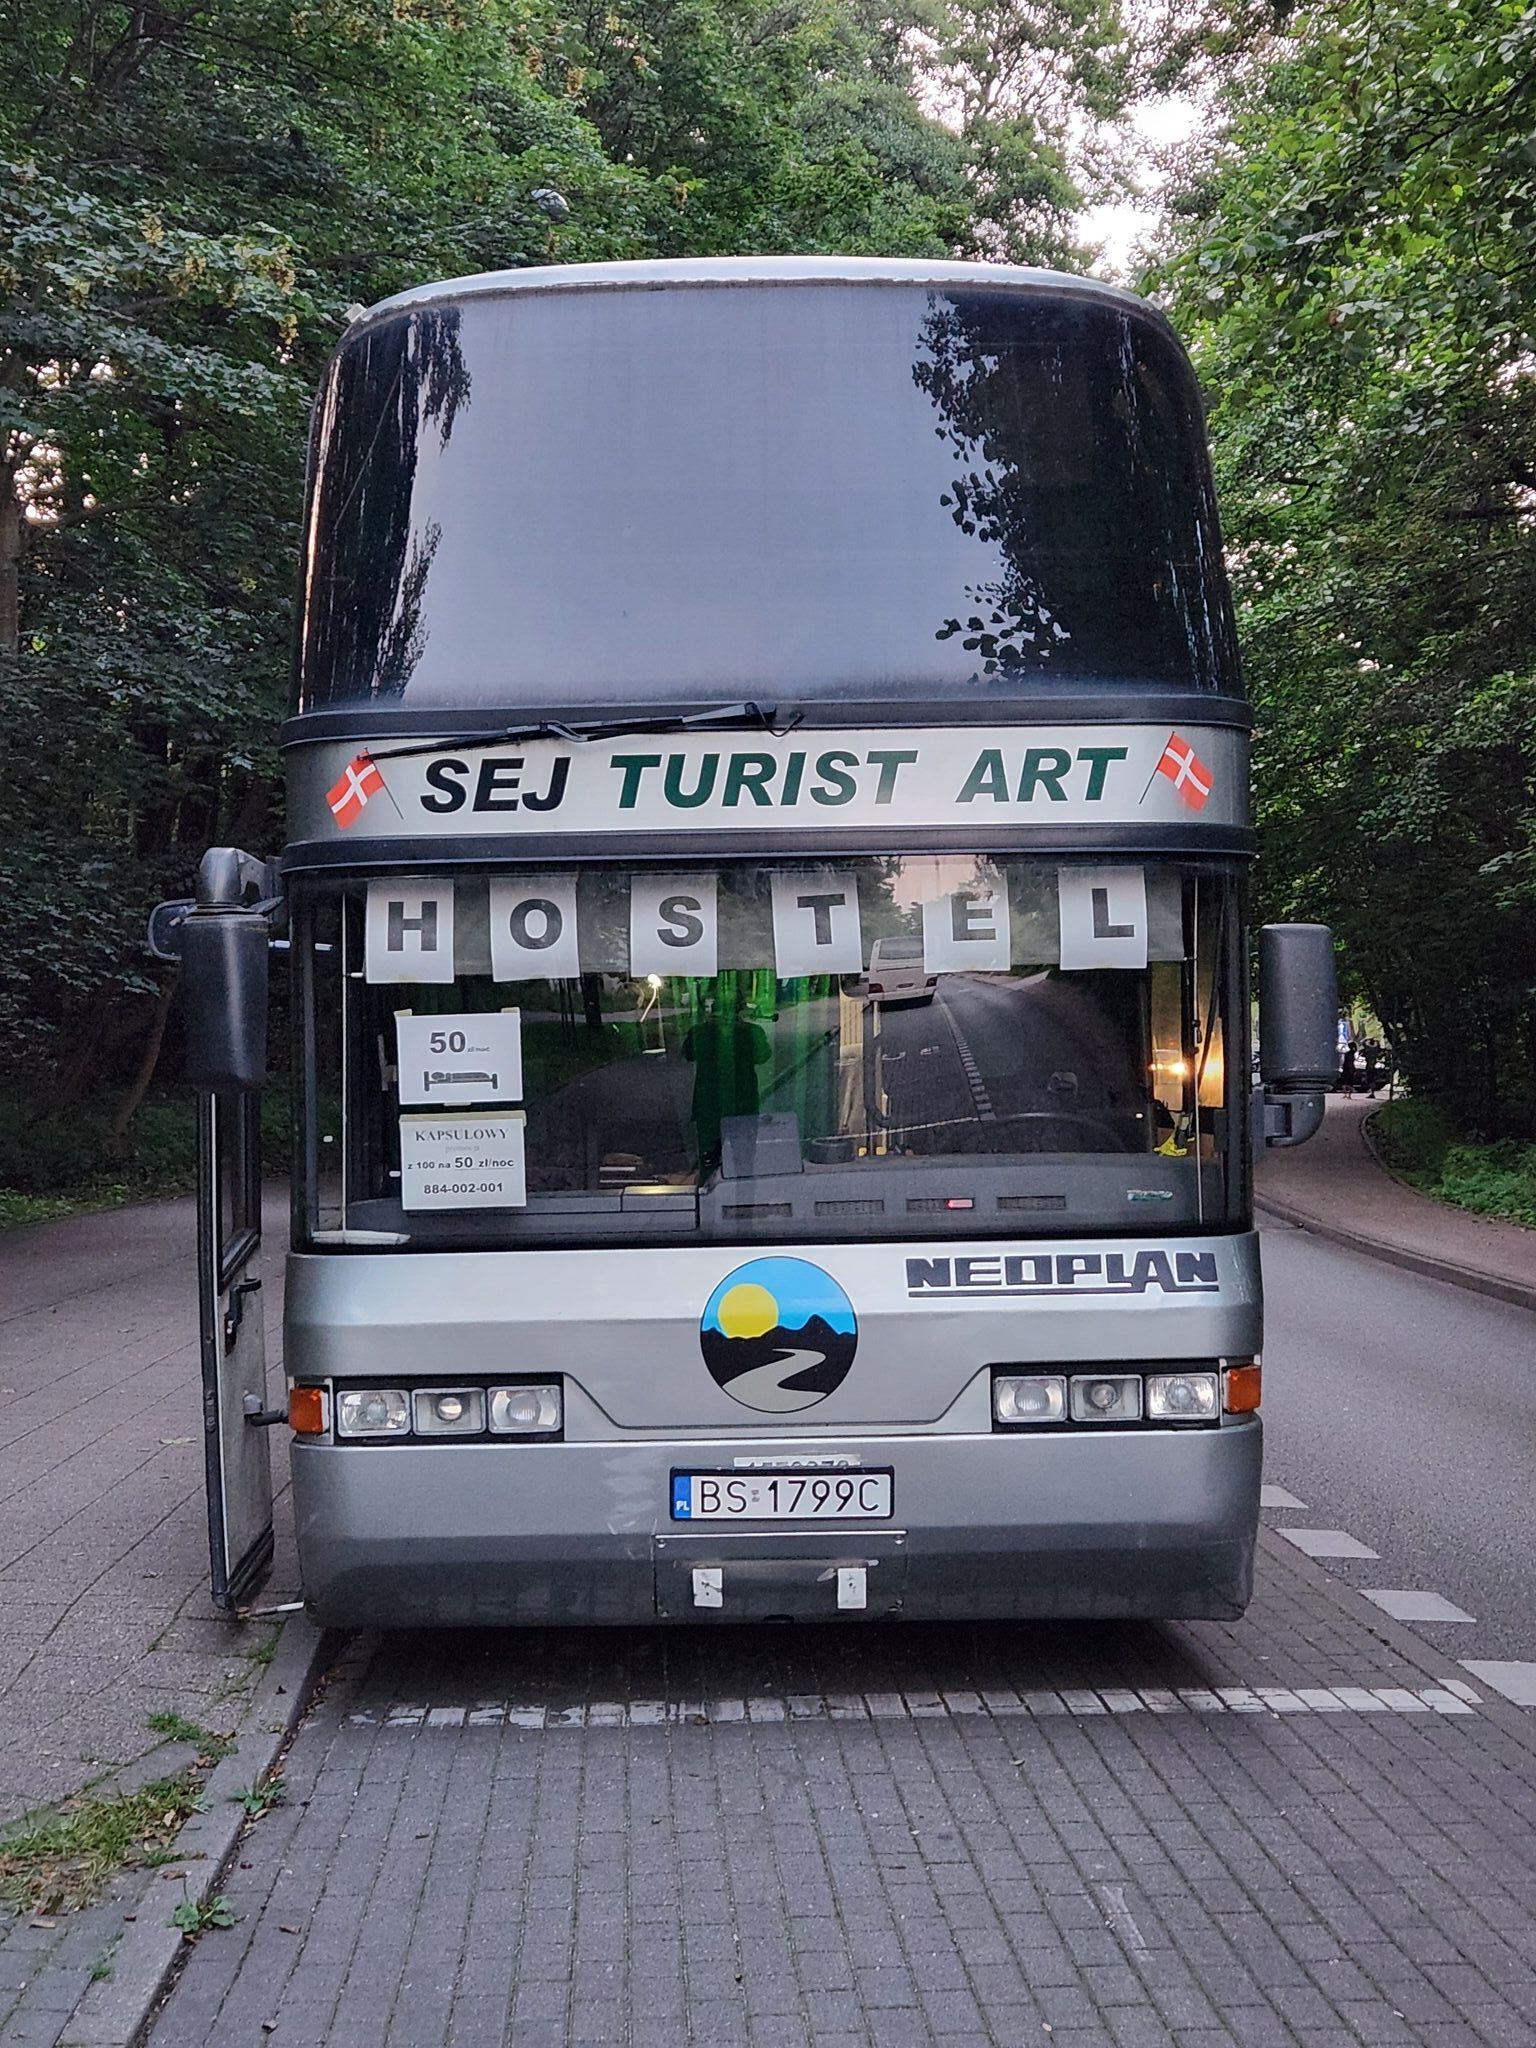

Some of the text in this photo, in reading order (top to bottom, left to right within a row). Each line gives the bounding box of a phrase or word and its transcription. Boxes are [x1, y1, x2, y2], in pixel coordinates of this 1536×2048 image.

[420, 747, 1128, 814] SEJ TURIST ART
[430, 1031, 466, 1054] 50
[416, 1161, 435, 1169] 100
[454, 1157, 473, 1168] 50
[423, 1182, 503, 1194] 884-002-001
[906, 1250, 1219, 1297] NEOPLAN
[676, 1500, 690, 1511] PL
[700, 1478, 880, 1513] BS 1799C
